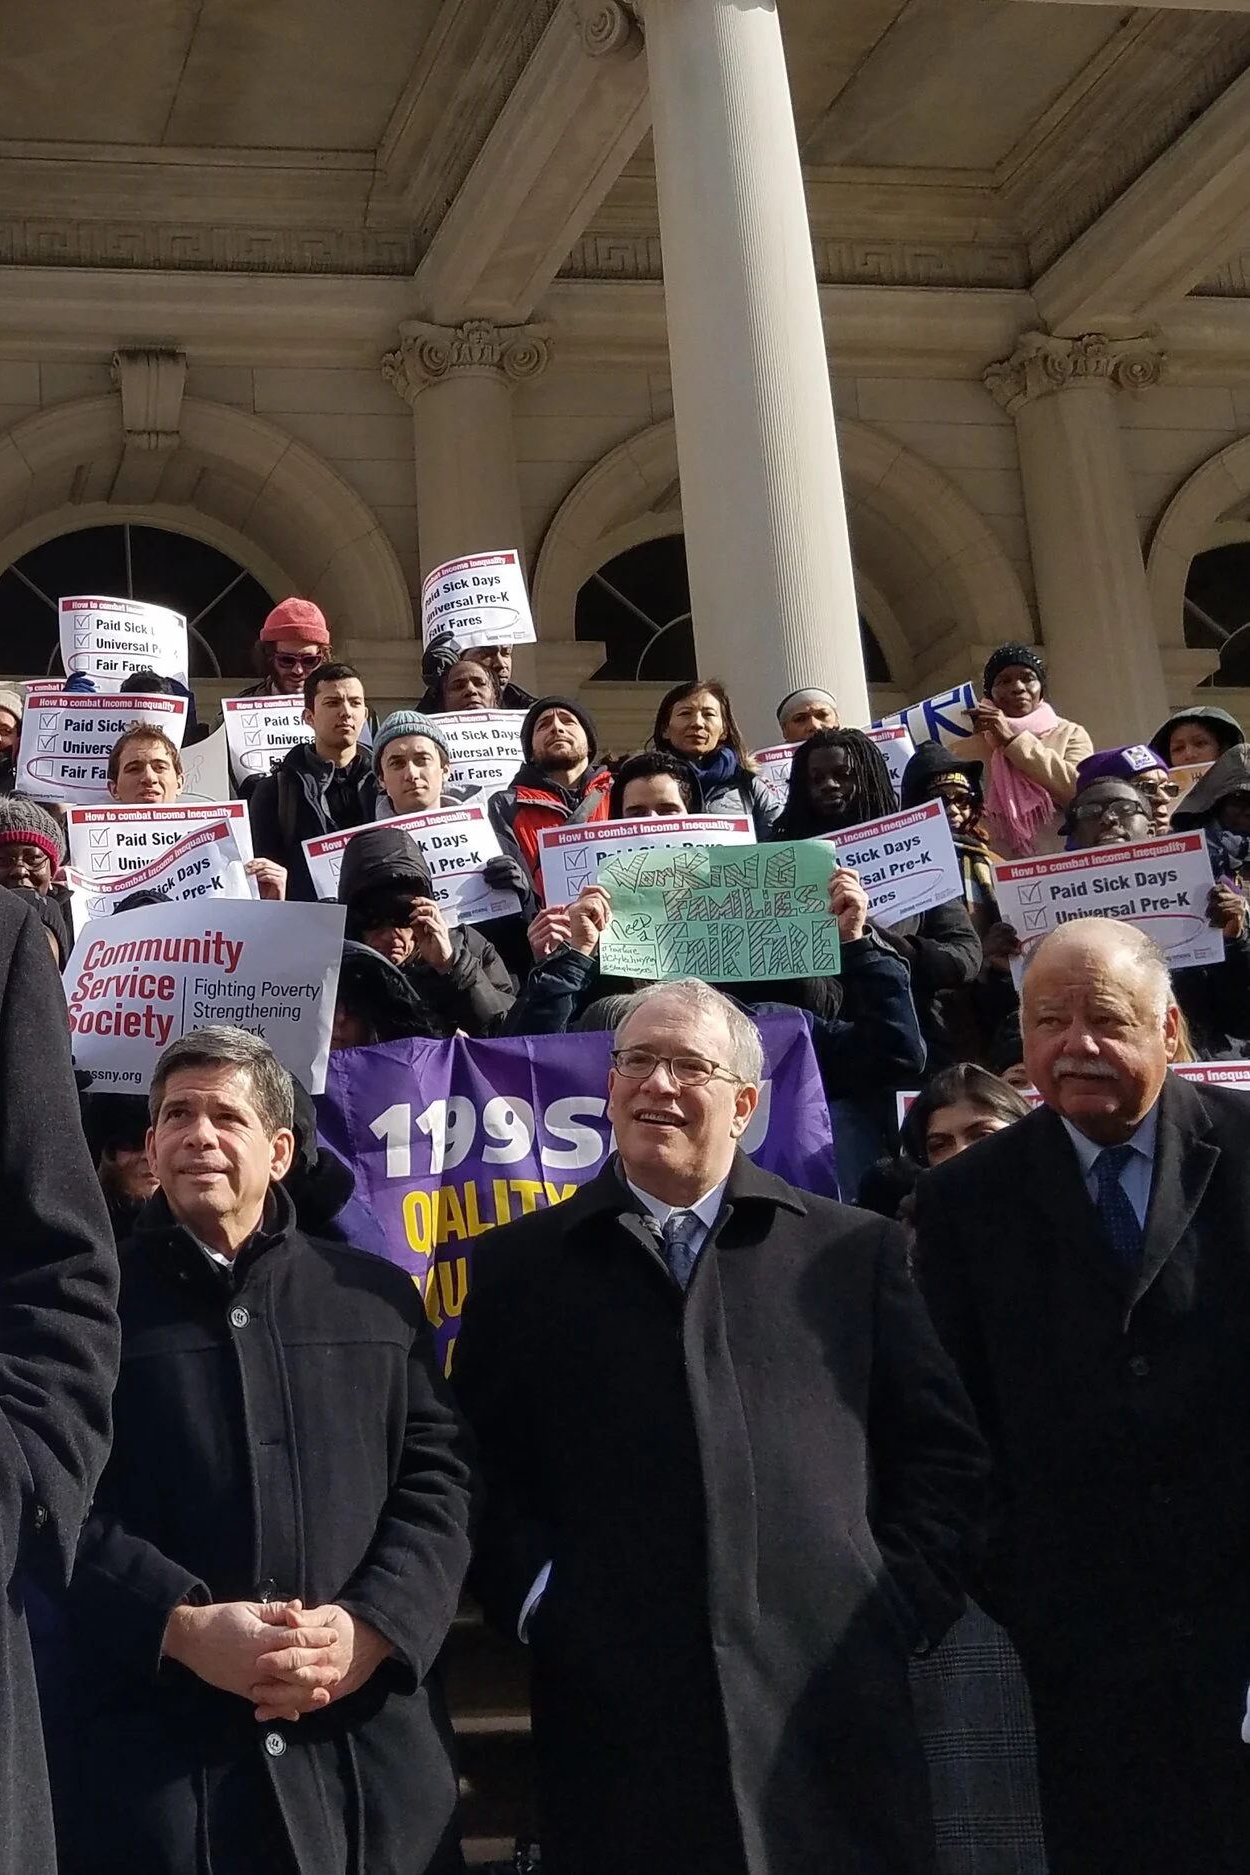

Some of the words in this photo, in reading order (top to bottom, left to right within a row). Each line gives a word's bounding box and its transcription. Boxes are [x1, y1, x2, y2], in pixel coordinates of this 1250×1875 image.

[443, 579, 469, 594] Sick
[472, 576, 501, 588] Days
[477, 591, 509, 607] Pre-K
[97, 619, 120, 630] Paid
[125, 622, 148, 634] Sick
[449, 616, 482, 629] Fares
[97, 638, 149, 653] Universal
[97, 659, 118, 670] Fair
[123, 661, 153, 673] Fares
[39, 698, 57, 707] How
[70, 698, 100, 707] combat
[134, 700, 175, 712] inequality
[64, 719, 93, 731] Paid
[97, 719, 126, 732] Sick
[264, 716, 290, 726] Paid
[267, 734, 315, 745] Universa
[461, 730, 489, 740] Sick
[492, 729, 520, 740] Days
[63, 741, 112, 755] Univers
[450, 747, 493, 759] iversal
[497, 746, 523, 756] Pre-
[61, 766, 87, 779] Fair
[468, 768, 502, 779] Fares
[85, 812, 104, 822] How
[107, 811, 116, 821] to
[118, 809, 151, 820] combat
[558, 832, 581, 844] How
[584, 830, 594, 840] to
[597, 826, 638, 839] combat
[844, 828, 879, 843] income
[880, 811, 927, 832] inequality
[116, 833, 146, 847] Paid
[152, 832, 182, 845] Sick
[321, 840, 343, 852] How
[431, 833, 468, 851] Days
[846, 849, 880, 866] Sick
[883, 836, 921, 855] Days
[1011, 867, 1034, 878] How
[1037, 864, 1047, 874] to
[1050, 856, 1090, 873] combat
[1091, 851, 1131, 865] income
[1133, 841, 1186, 860] inequality
[177, 857, 211, 881] Days
[439, 851, 482, 872] Pre-K
[889, 851, 932, 876] Pre-K
[114, 872, 147, 891] combat
[181, 875, 224, 901] Pre-K
[1050, 881, 1088, 900] Paid
[1092, 876, 1130, 894] Sick
[1135, 870, 1178, 887] Days
[867, 891, 896, 909] ares
[1055, 900, 1136, 925] Universal
[1140, 892, 1191, 913] Pre-K
[83, 931, 244, 974] Community
[71, 966, 175, 1001] Service
[195, 978, 256, 1000] Fighting
[261, 981, 322, 1001] Poverty
[193, 1002, 301, 1022] Strengthening
[67, 1002, 174, 1046] Society
[91, 1069, 142, 1084] ssny.org
[1206, 1070, 1250, 1082] inequa
